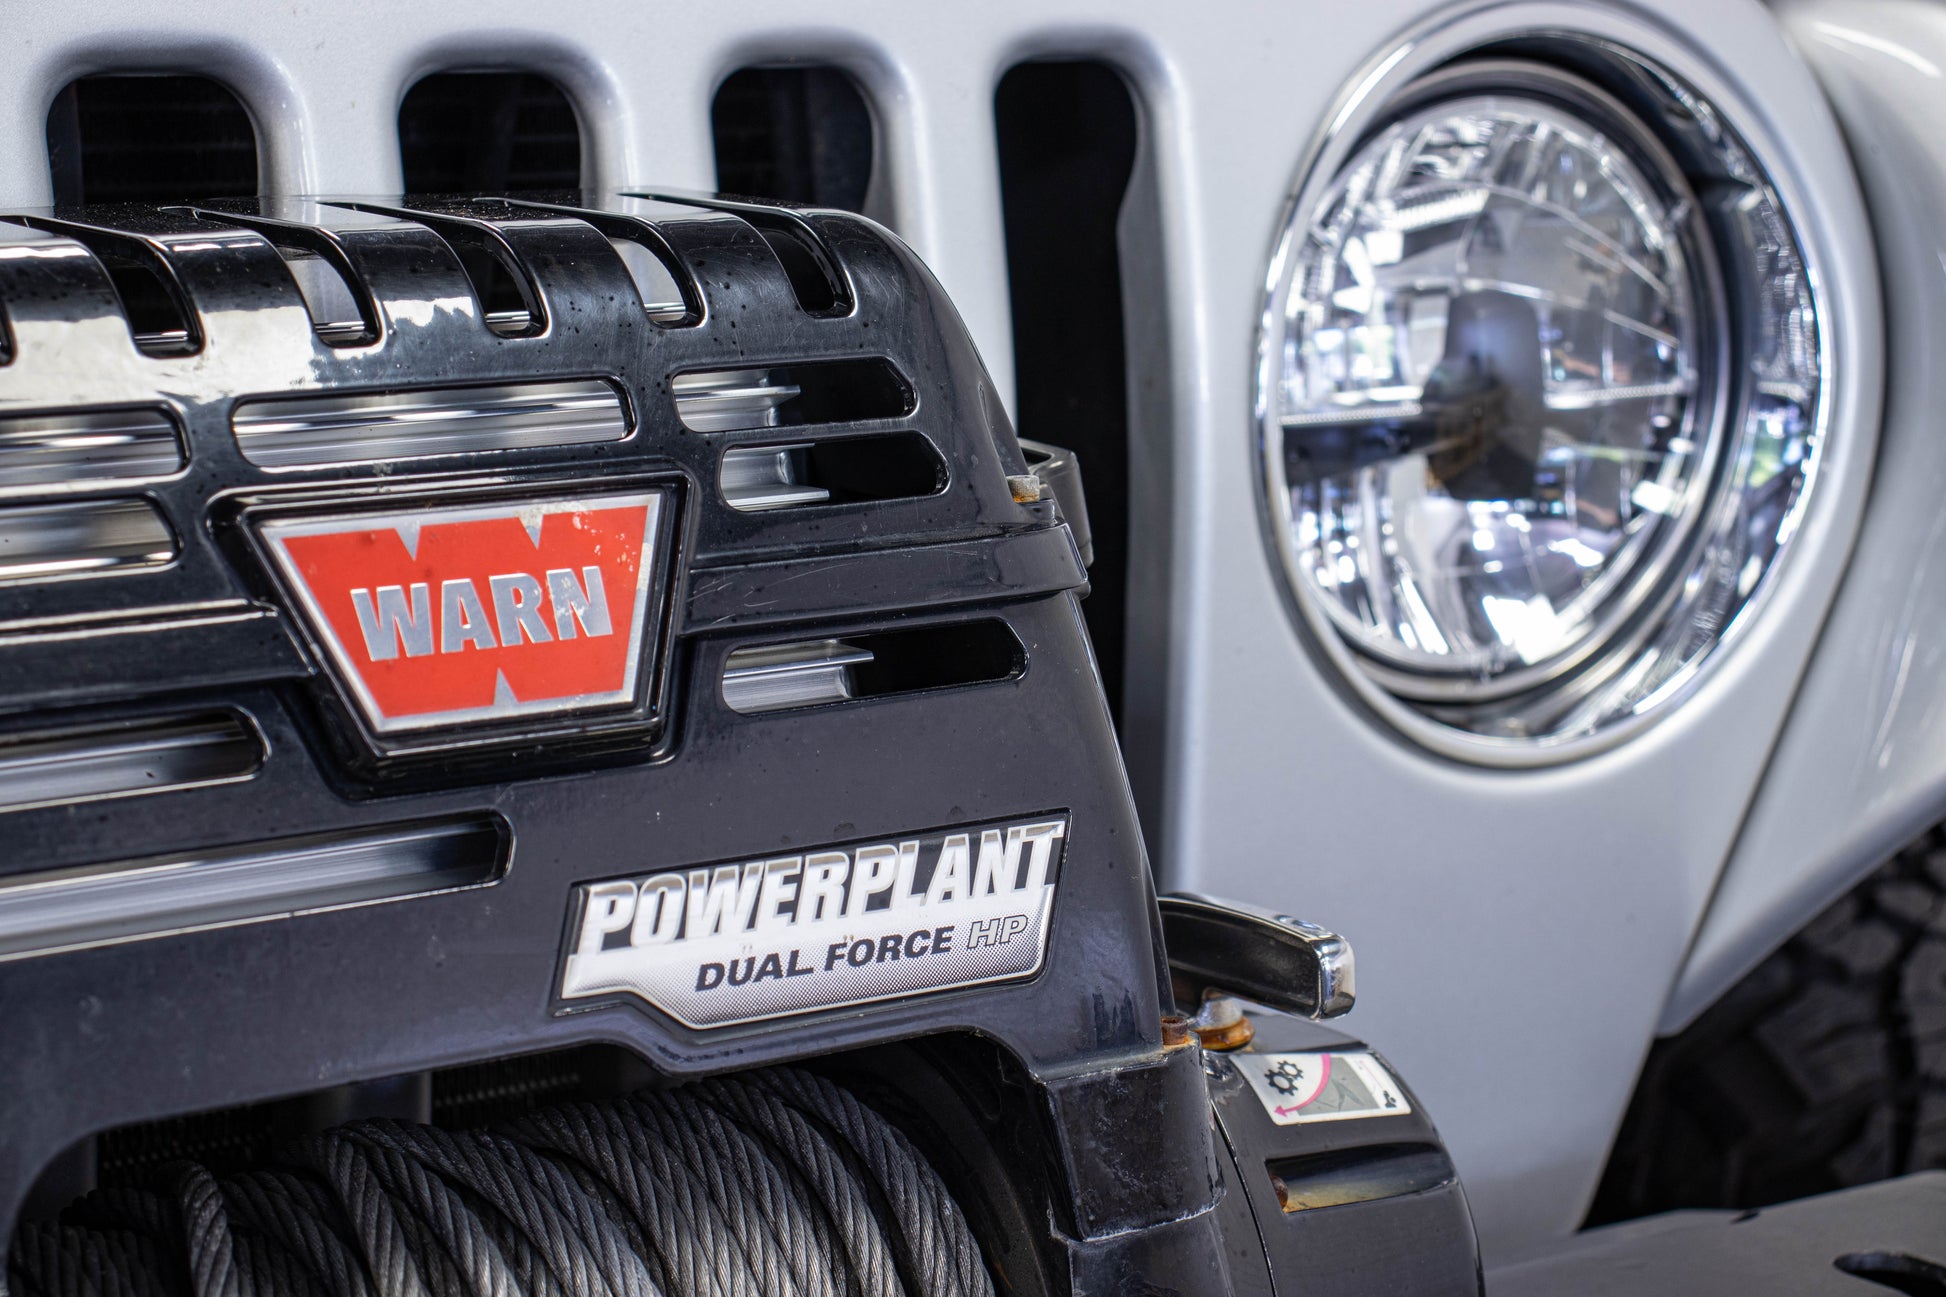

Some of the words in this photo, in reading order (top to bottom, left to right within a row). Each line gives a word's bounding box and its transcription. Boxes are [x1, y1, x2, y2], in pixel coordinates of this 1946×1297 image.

[350, 566, 613, 662] WARN
[577, 821, 1065, 956] POWERPLANT
[695, 949, 814, 991] DUAL
[824, 925, 955, 972] FORCE
[967, 914, 1029, 949] HP
